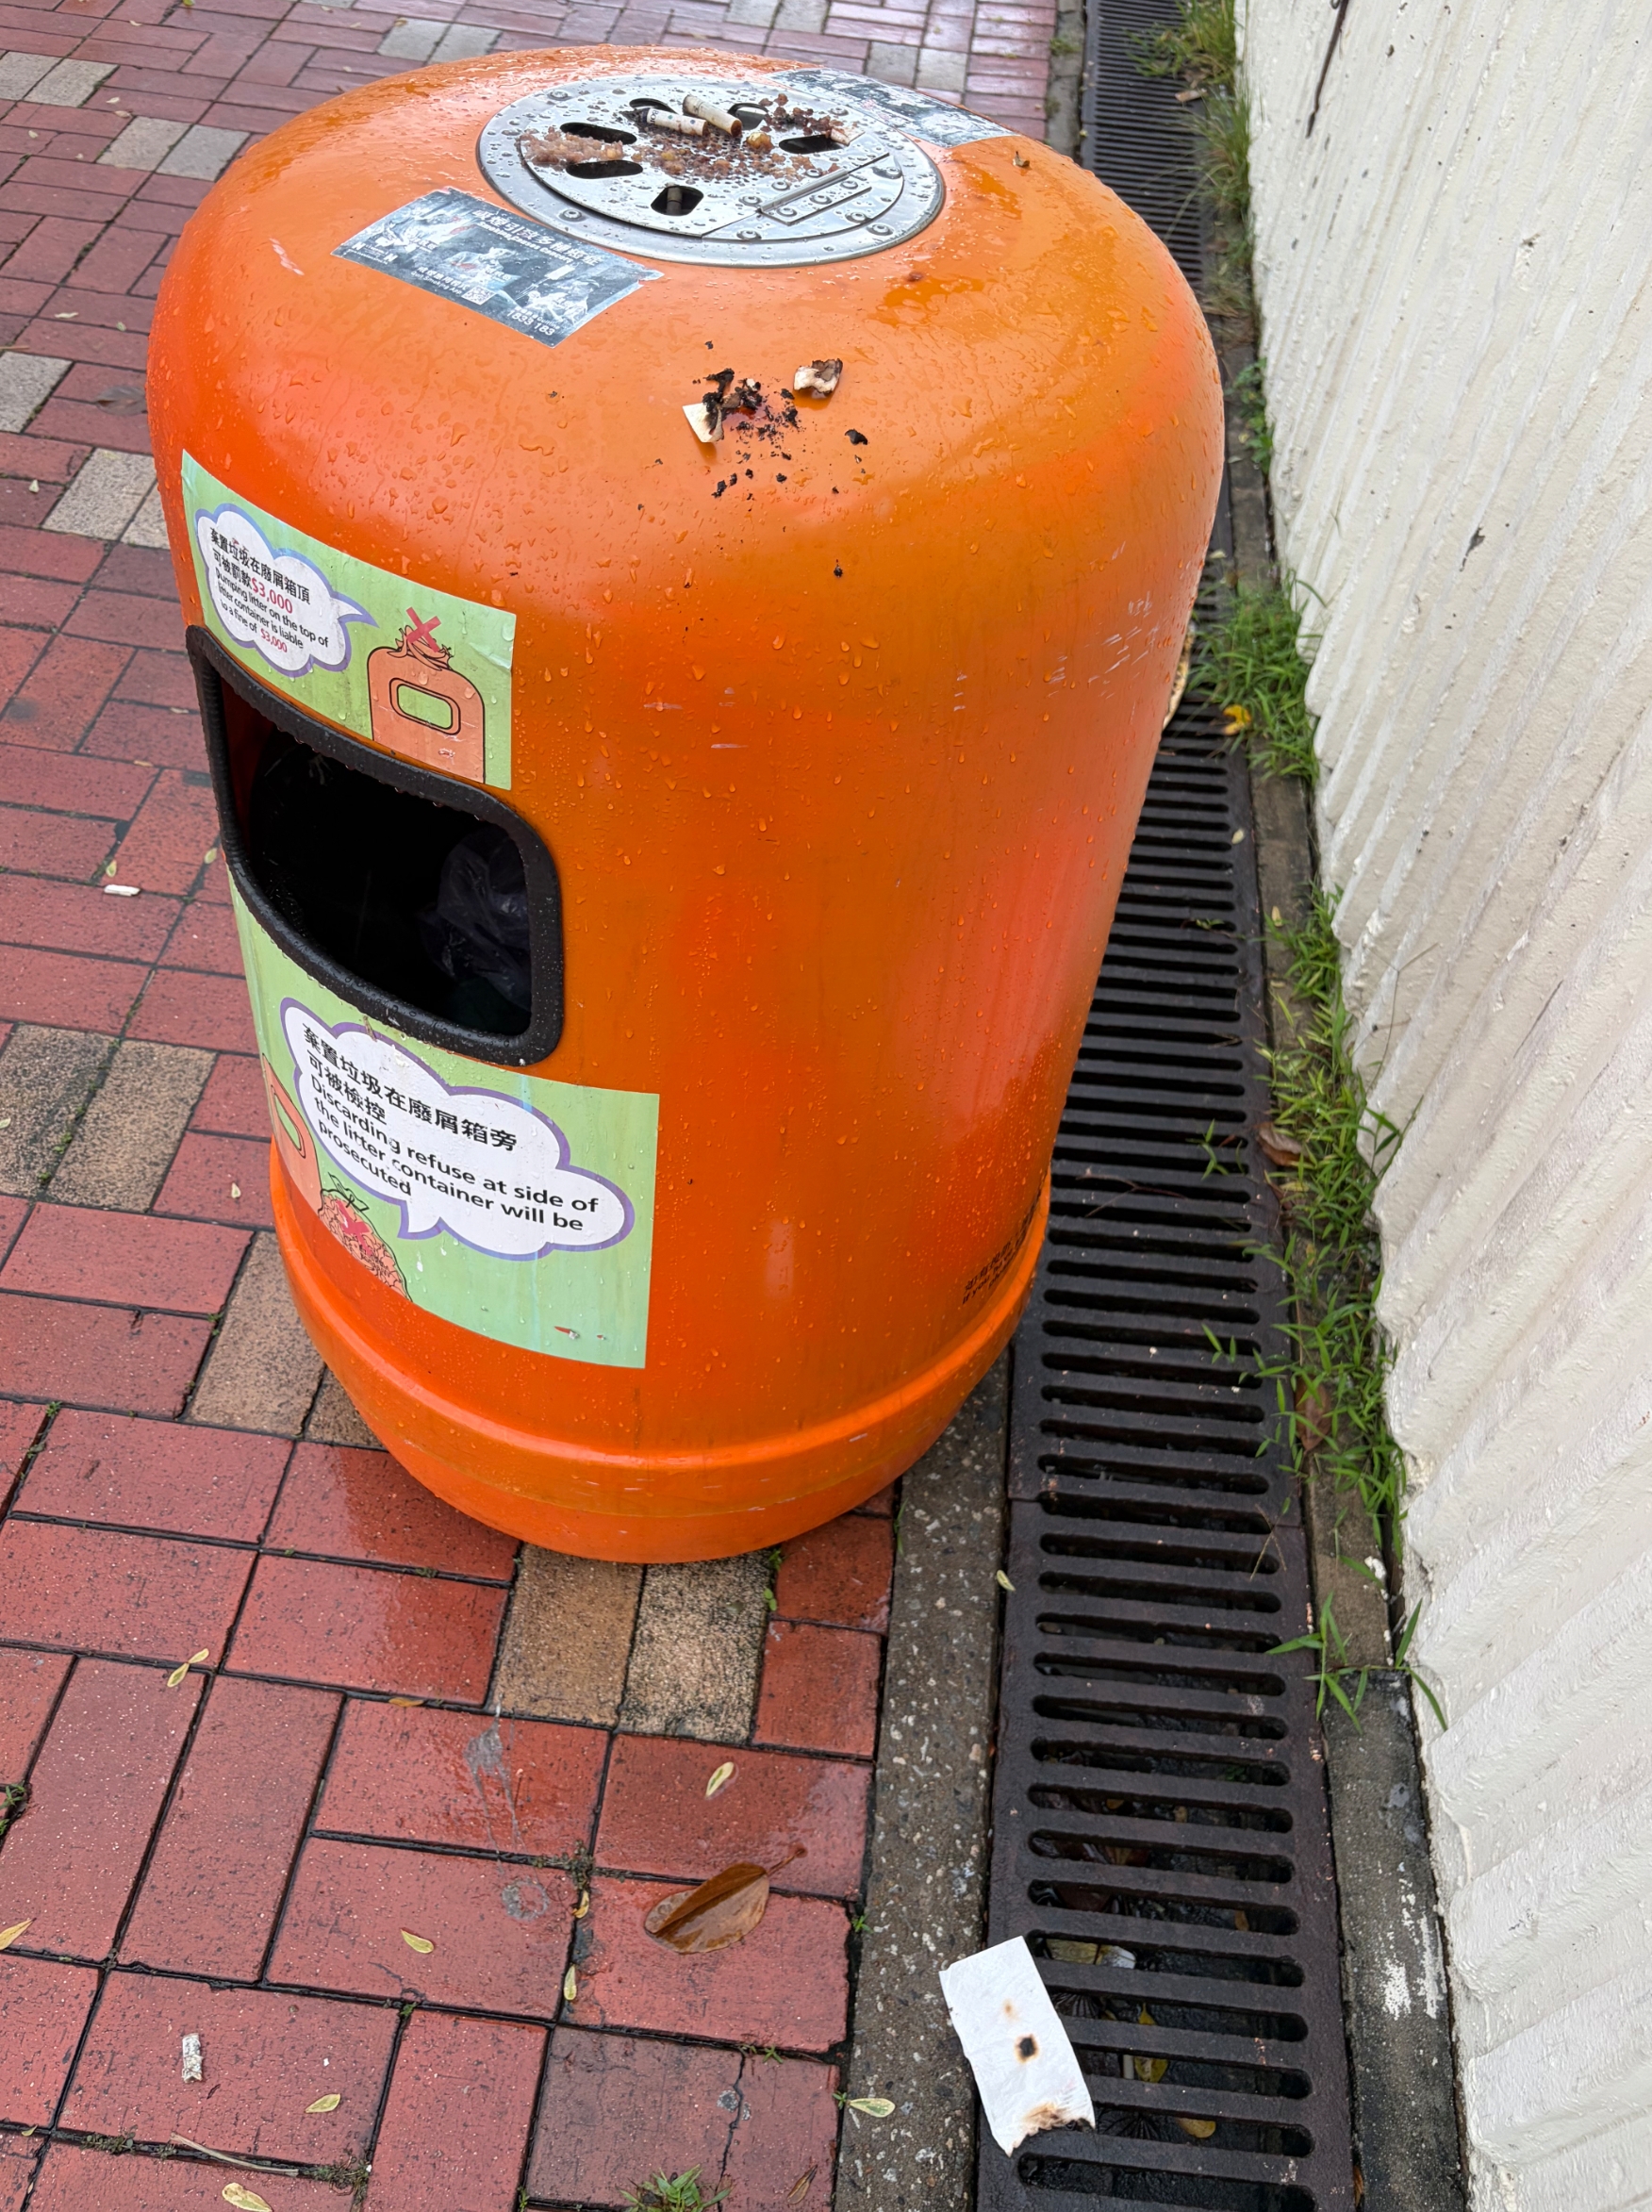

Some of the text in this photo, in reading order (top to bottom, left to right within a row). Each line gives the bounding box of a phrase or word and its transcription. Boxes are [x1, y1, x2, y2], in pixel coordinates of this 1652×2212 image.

[477, 222, 573, 264] Smoking Causes Cancers
[422, 275, 450, 290] Smoking
[449, 287, 463, 296] App
[506, 309, 535, 325] 1833
[534, 322, 555, 336] 183
[215, 567, 329, 648] Dumping litter on the top of
[218, 581, 304, 649] litter container is liable
[229, 607, 234, 616] a
[234, 609, 248, 627] fine
[249, 622, 257, 634] of
[260, 627, 288, 652] $3,000
[303, 1023, 517, 1151] 棄置垃圾在廢屑箱旁
[306, 1048, 387, 1125] 可被檢控
[311, 1074, 599, 1213] Discarding refuse at side of
[314, 1097, 584, 1230] the litter container will be
[318, 1118, 412, 1197] prosecuted
